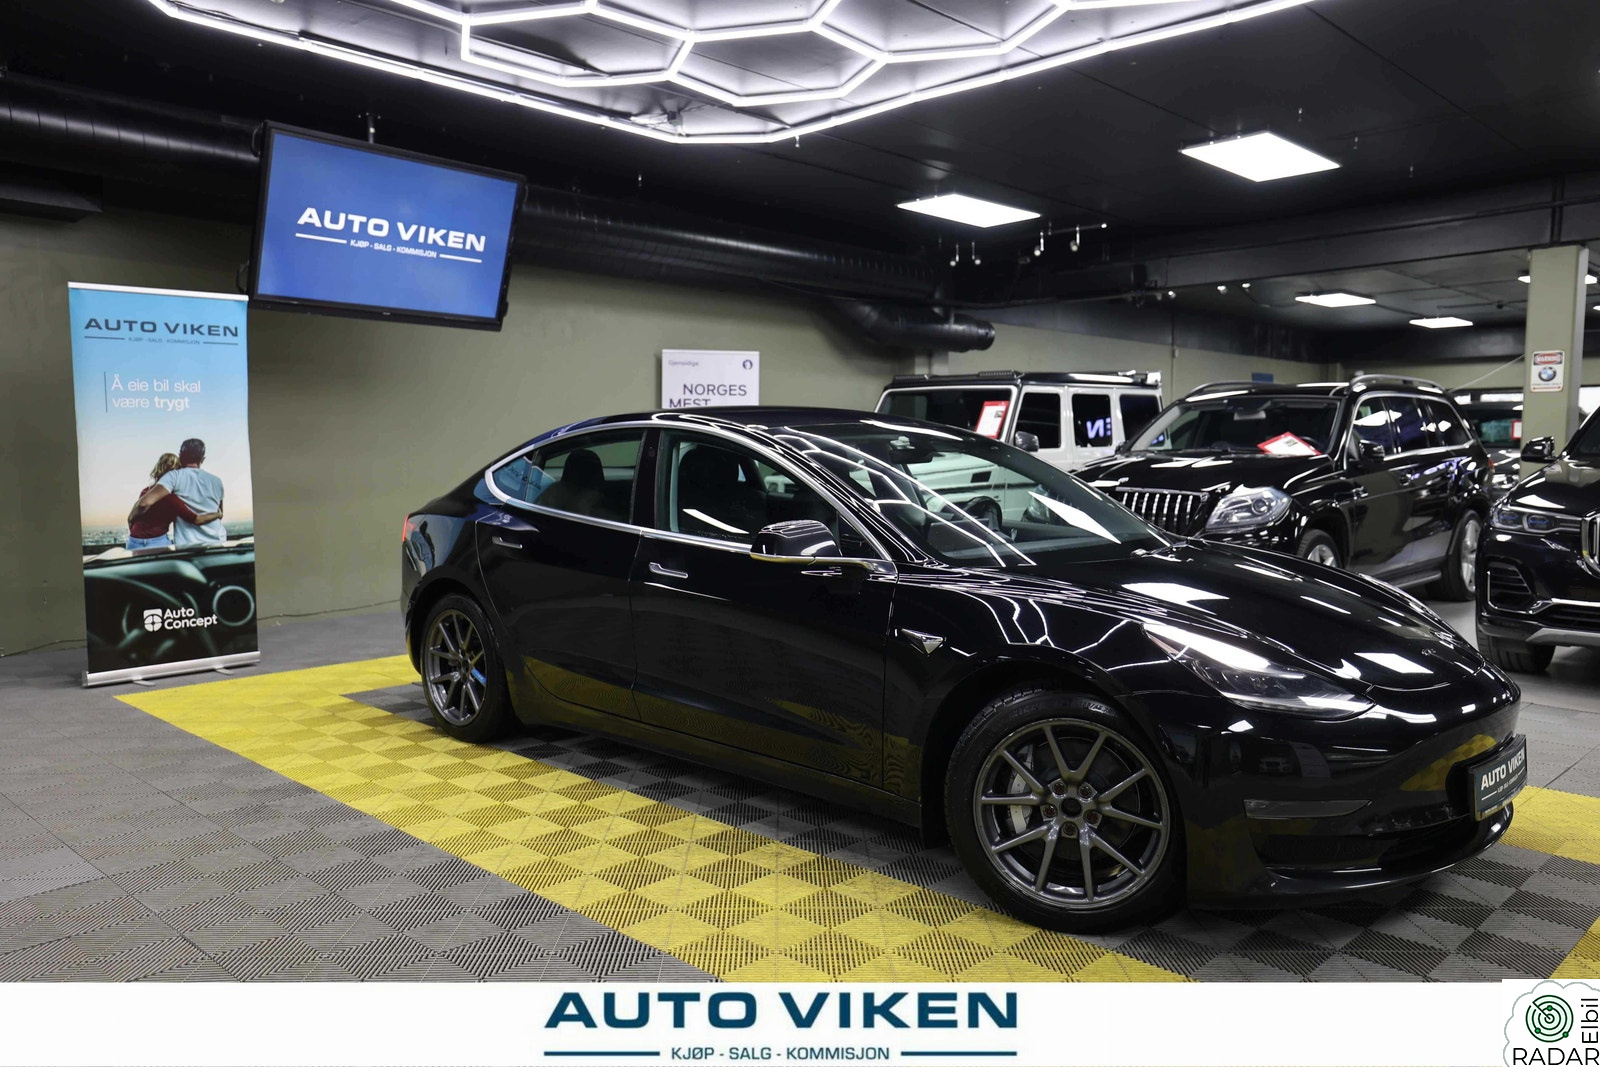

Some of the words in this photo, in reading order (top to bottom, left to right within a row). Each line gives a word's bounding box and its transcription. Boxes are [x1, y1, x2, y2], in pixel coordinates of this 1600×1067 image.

[297, 207, 389, 238] AUTO
[396, 222, 486, 252] VIKEN
[374, 243, 392, 252] SALG
[396, 246, 437, 258] KOMMISJON
[84, 318, 157, 333] AUTO
[163, 322, 238, 337] VIKEN
[112, 374, 124, 390] Å
[128, 379, 149, 391] eie
[153, 379, 169, 391] bil
[174, 380, 201, 393] skal
[683, 384, 747, 396] NORGES
[112, 398, 149, 408] være
[154, 396, 190, 412] trygt
[669, 398, 711, 408] MEST
[164, 607, 194, 619] Auto
[164, 614, 218, 630] Concept
[1481, 764, 1506, 790] AUTO
[1508, 746, 1525, 773] VIKEN
